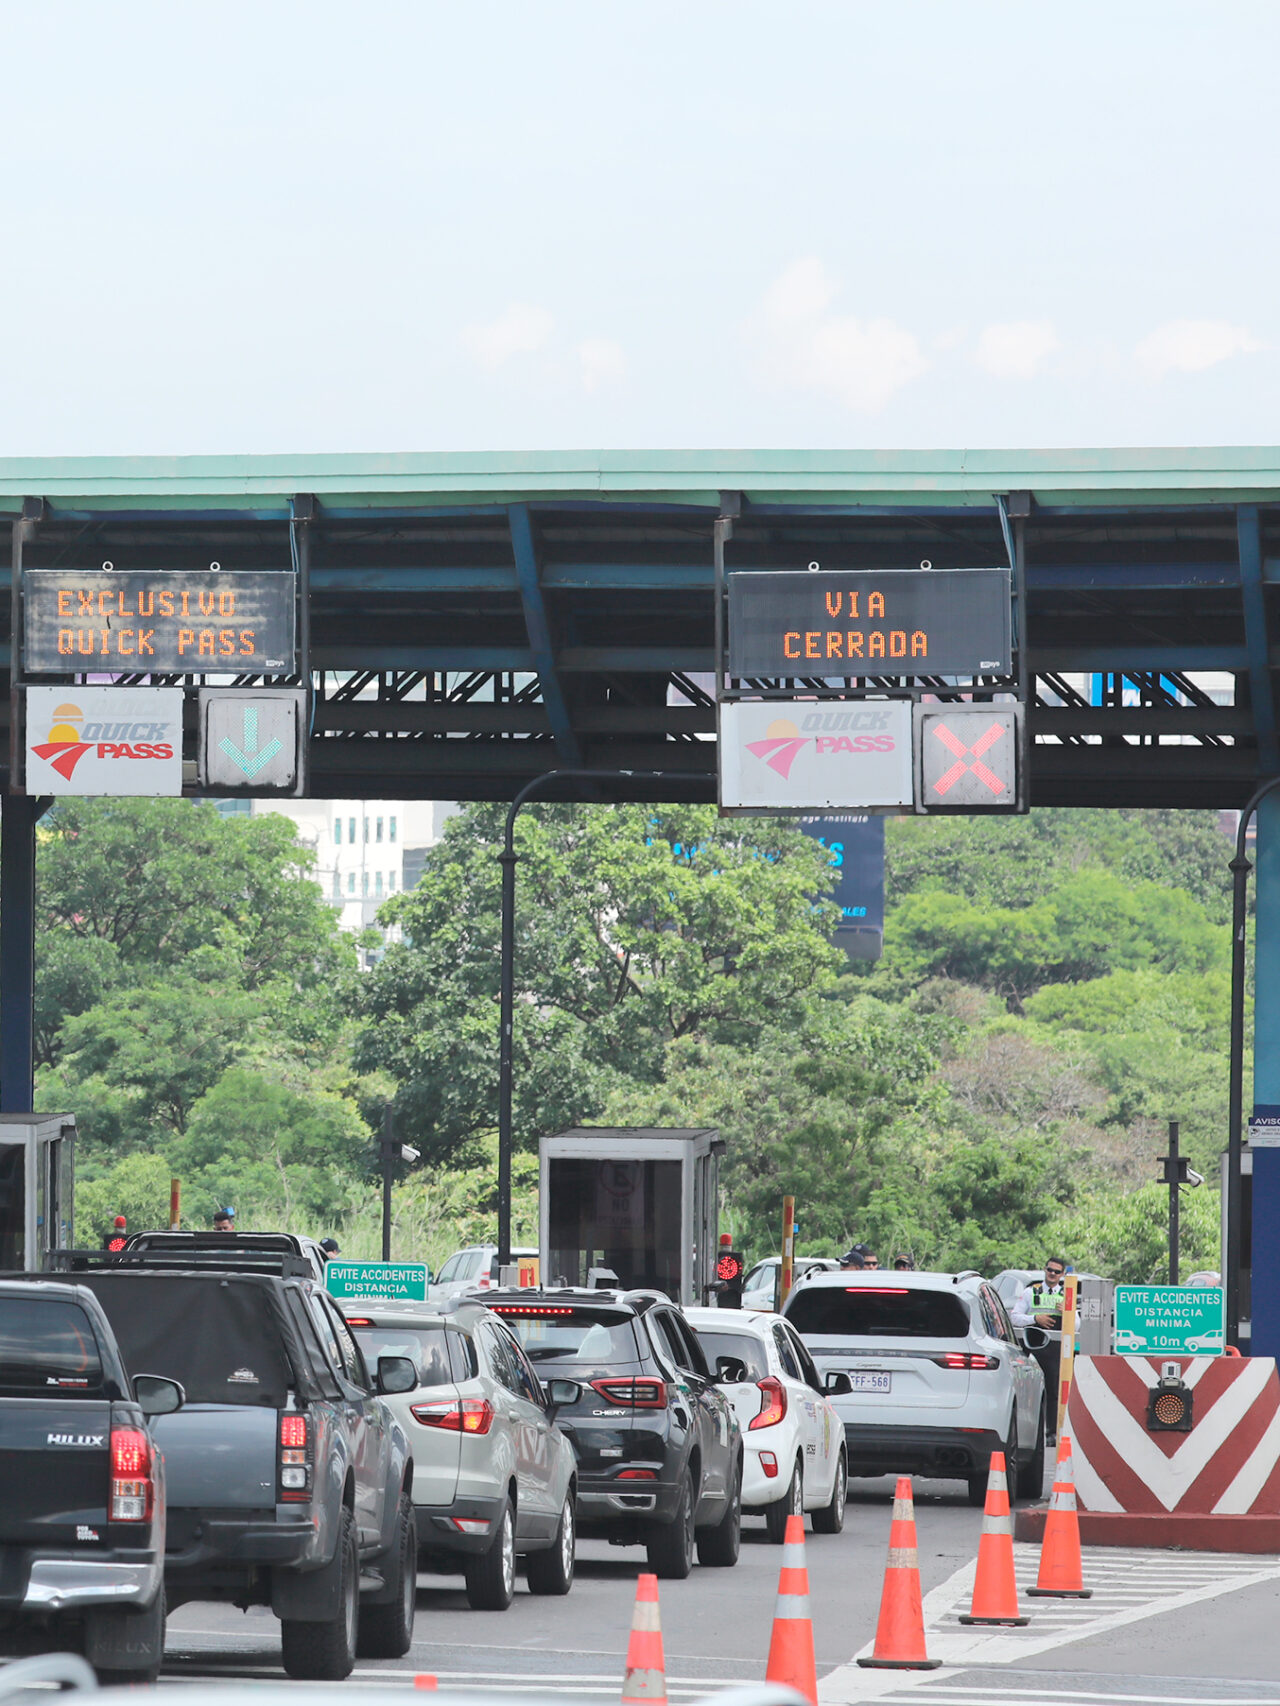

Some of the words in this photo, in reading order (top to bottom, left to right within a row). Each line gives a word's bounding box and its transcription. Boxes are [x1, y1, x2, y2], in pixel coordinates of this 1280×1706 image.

[57, 590, 236, 617] EXCLUSIVO
[825, 591, 885, 618] VIA
[57, 629, 154, 655] QUICK
[178, 629, 256, 656] PASS
[784, 630, 928, 658] CERRADA
[801, 711, 892, 732] QUICK
[81, 722, 170, 741] QUICK
[97, 743, 174, 759] PASS
[816, 735, 896, 754] PASS
[330, 1268, 359, 1280] EVITE
[361, 1269, 425, 1282] ACCIDENTES
[344, 1282, 408, 1293] DISTANCIA
[1120, 1292, 1149, 1304] EVITE
[1153, 1292, 1220, 1305] ACCIDENTES
[1135, 1307, 1203, 1317] DISTANCIA
[1145, 1319, 1191, 1328] MINIMA
[1152, 1336, 1180, 1346] 10m
[47, 1433, 105, 1447] HILUX
